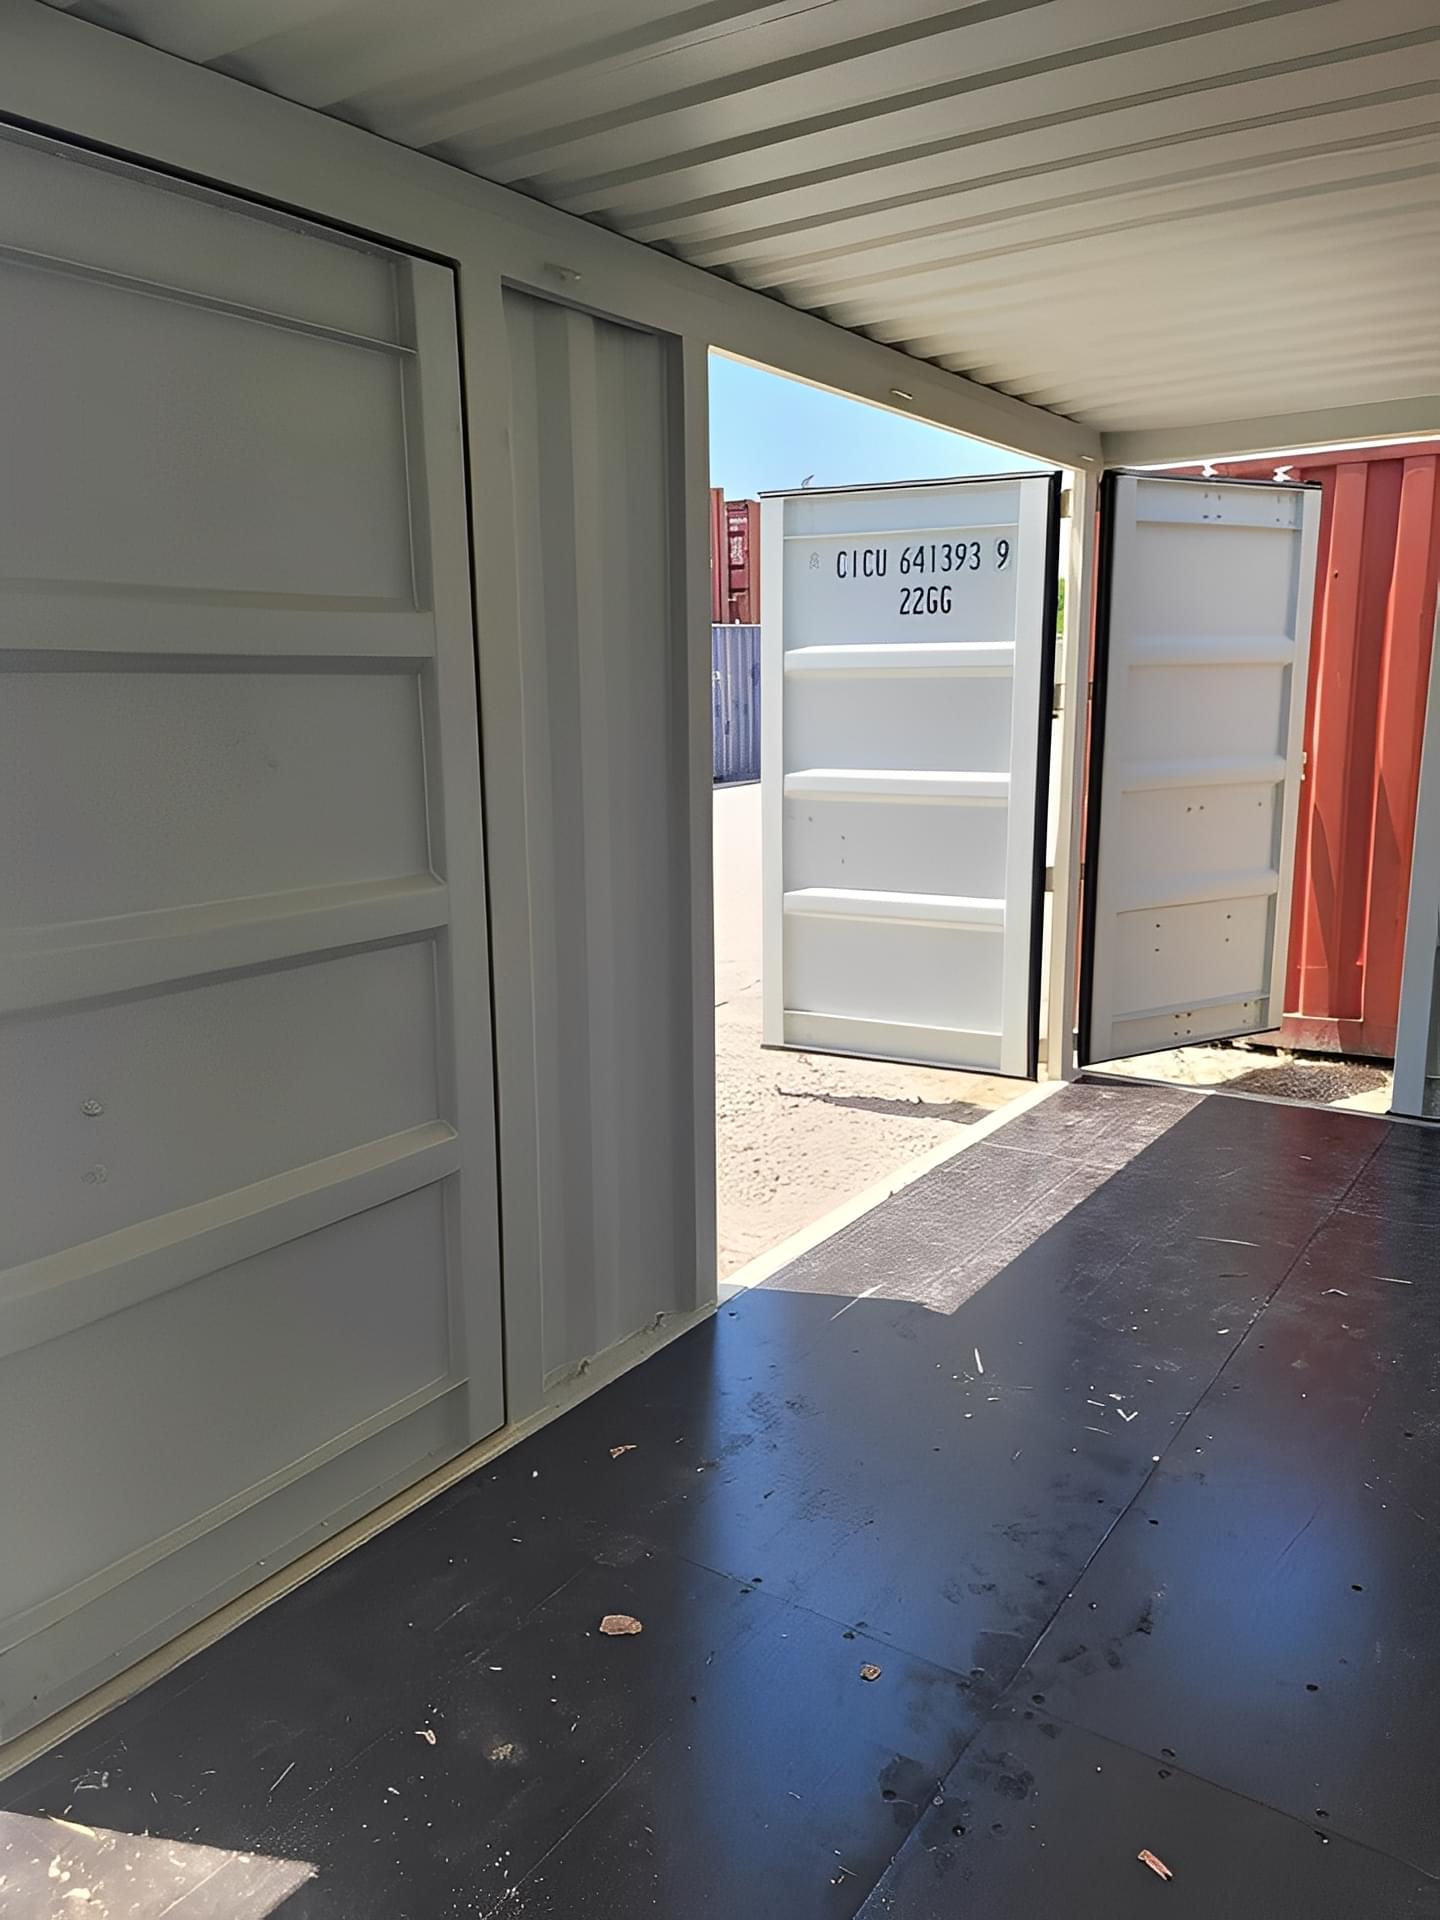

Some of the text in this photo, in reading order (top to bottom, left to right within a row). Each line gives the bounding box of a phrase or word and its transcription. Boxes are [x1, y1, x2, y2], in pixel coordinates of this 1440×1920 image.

[837, 540, 1010, 578] CICU 641393 9
[900, 586, 952, 615] 22GG
